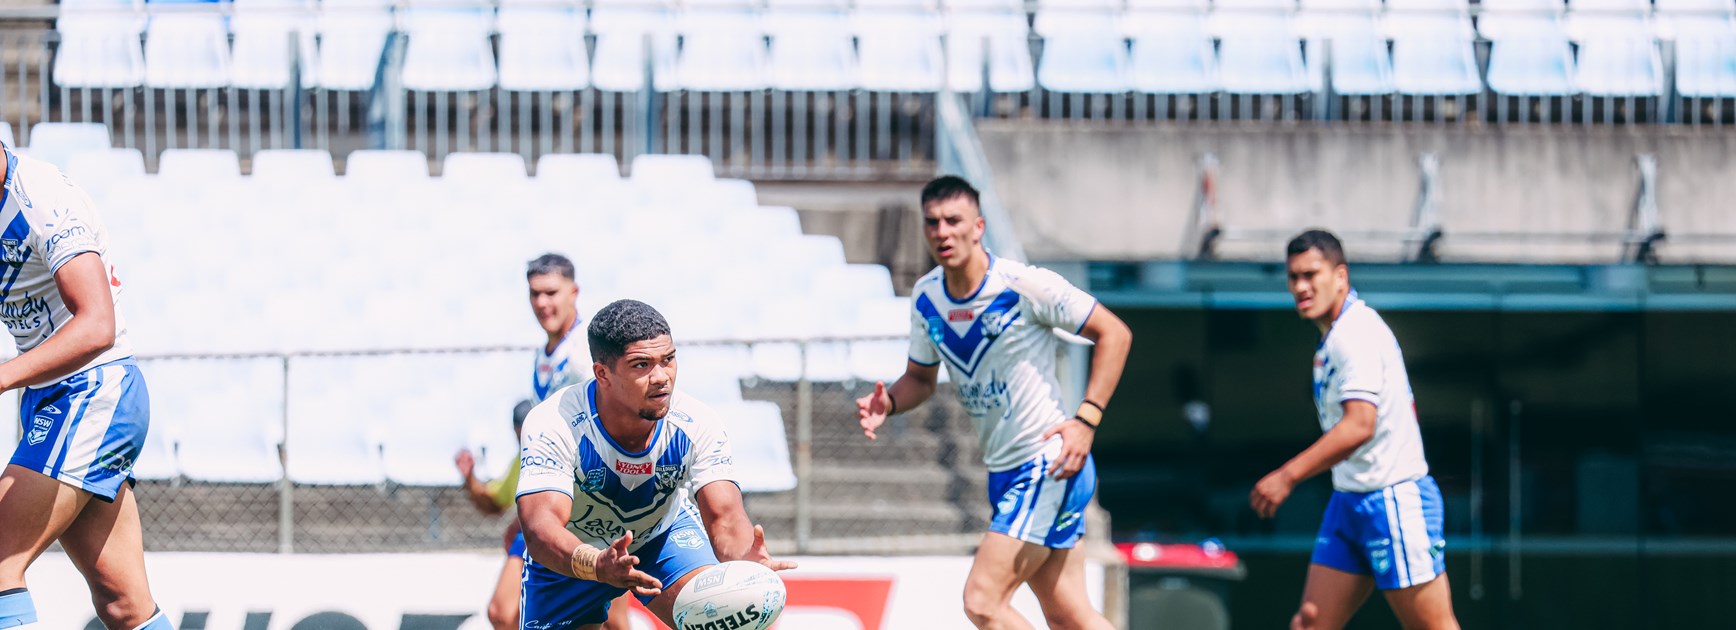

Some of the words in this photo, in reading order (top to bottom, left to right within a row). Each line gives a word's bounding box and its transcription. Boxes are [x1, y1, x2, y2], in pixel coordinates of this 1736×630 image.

[34, 417, 52, 428] NSW
[616, 460, 652, 470] SYDNEY
[619, 467, 647, 476] TOOLS
[670, 530, 696, 542] NSW
[697, 573, 721, 588] NSW
